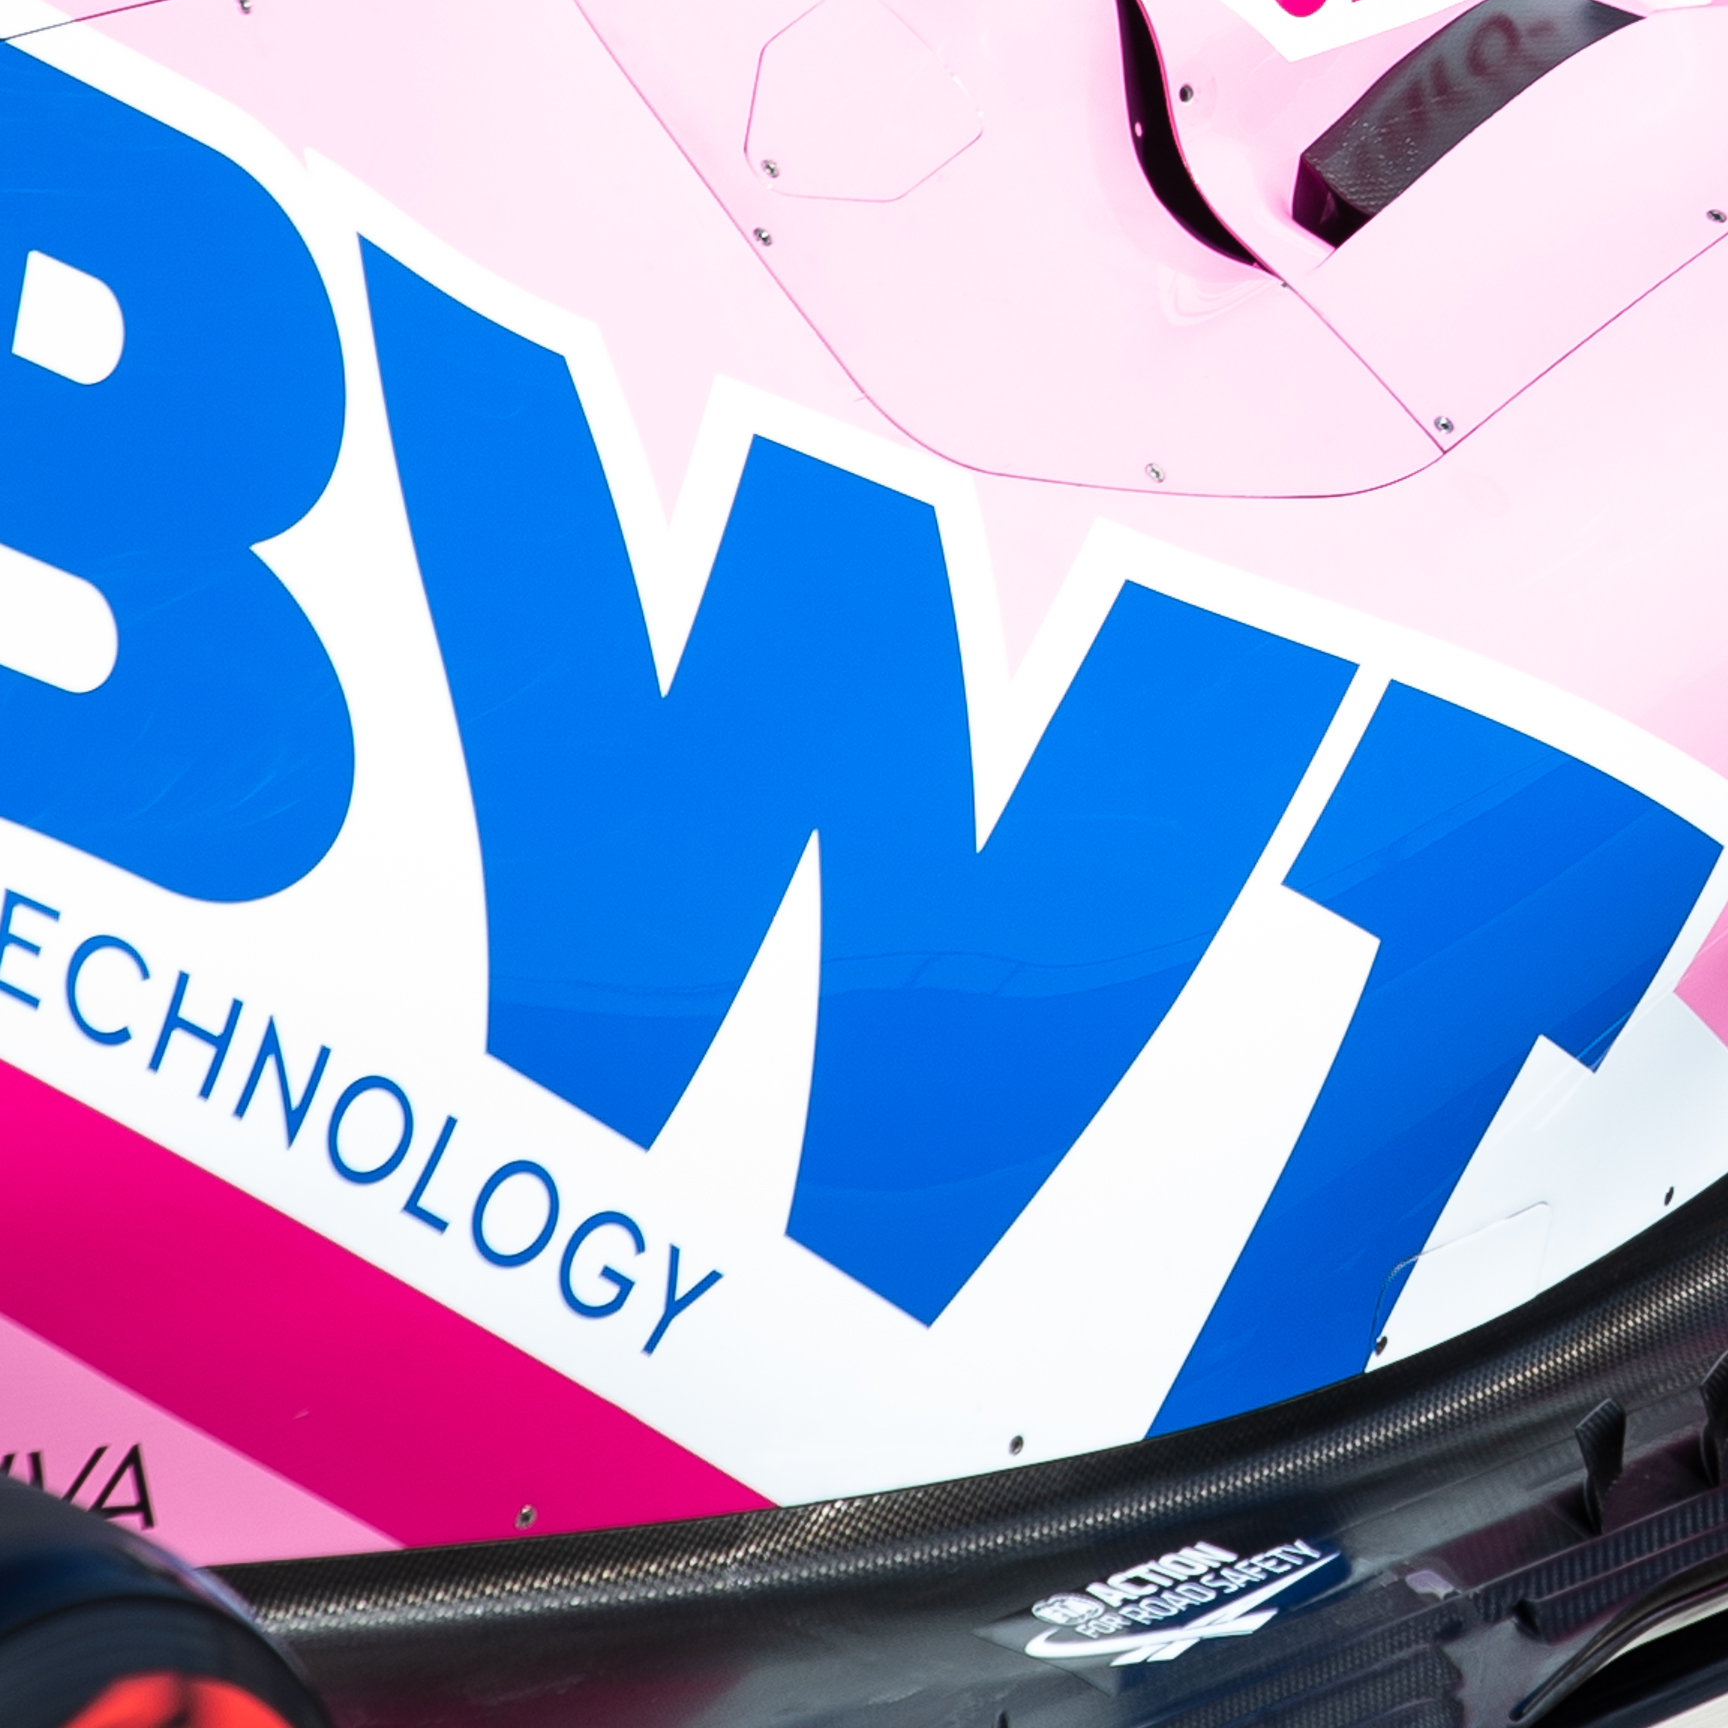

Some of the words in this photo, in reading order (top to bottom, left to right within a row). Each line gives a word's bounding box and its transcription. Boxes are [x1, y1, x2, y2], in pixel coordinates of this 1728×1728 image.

[0, 40, 1724, 1440] BWT
[0, 889, 724, 1357] ECHNOLOGY
[1075, 1605, 1132, 1639] FOR
[1118, 1580, 1217, 1626] ROAD
[1211, 1538, 1322, 1594] SAFETY
[1086, 1540, 1239, 1608] ACTION
